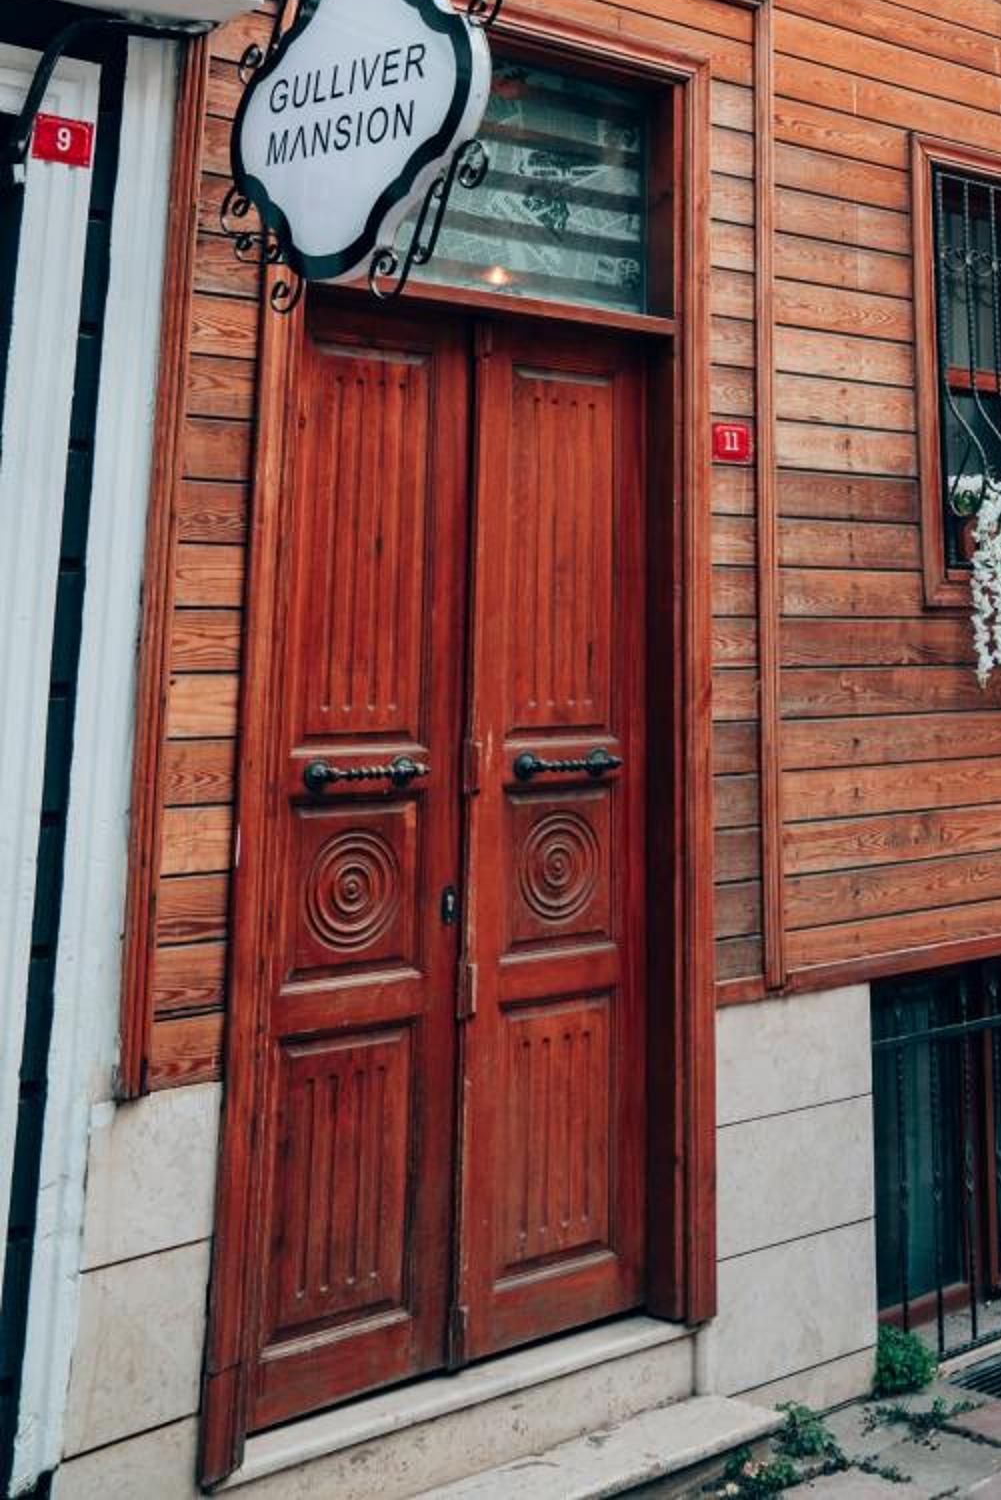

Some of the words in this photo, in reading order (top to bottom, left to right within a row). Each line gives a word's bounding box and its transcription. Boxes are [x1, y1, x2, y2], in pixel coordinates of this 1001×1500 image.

[269, 44, 426, 113] GULLIVER
[56, 127, 71, 151] 9
[266, 100, 415, 167] MANSION
[724, 431, 740, 451] 11
